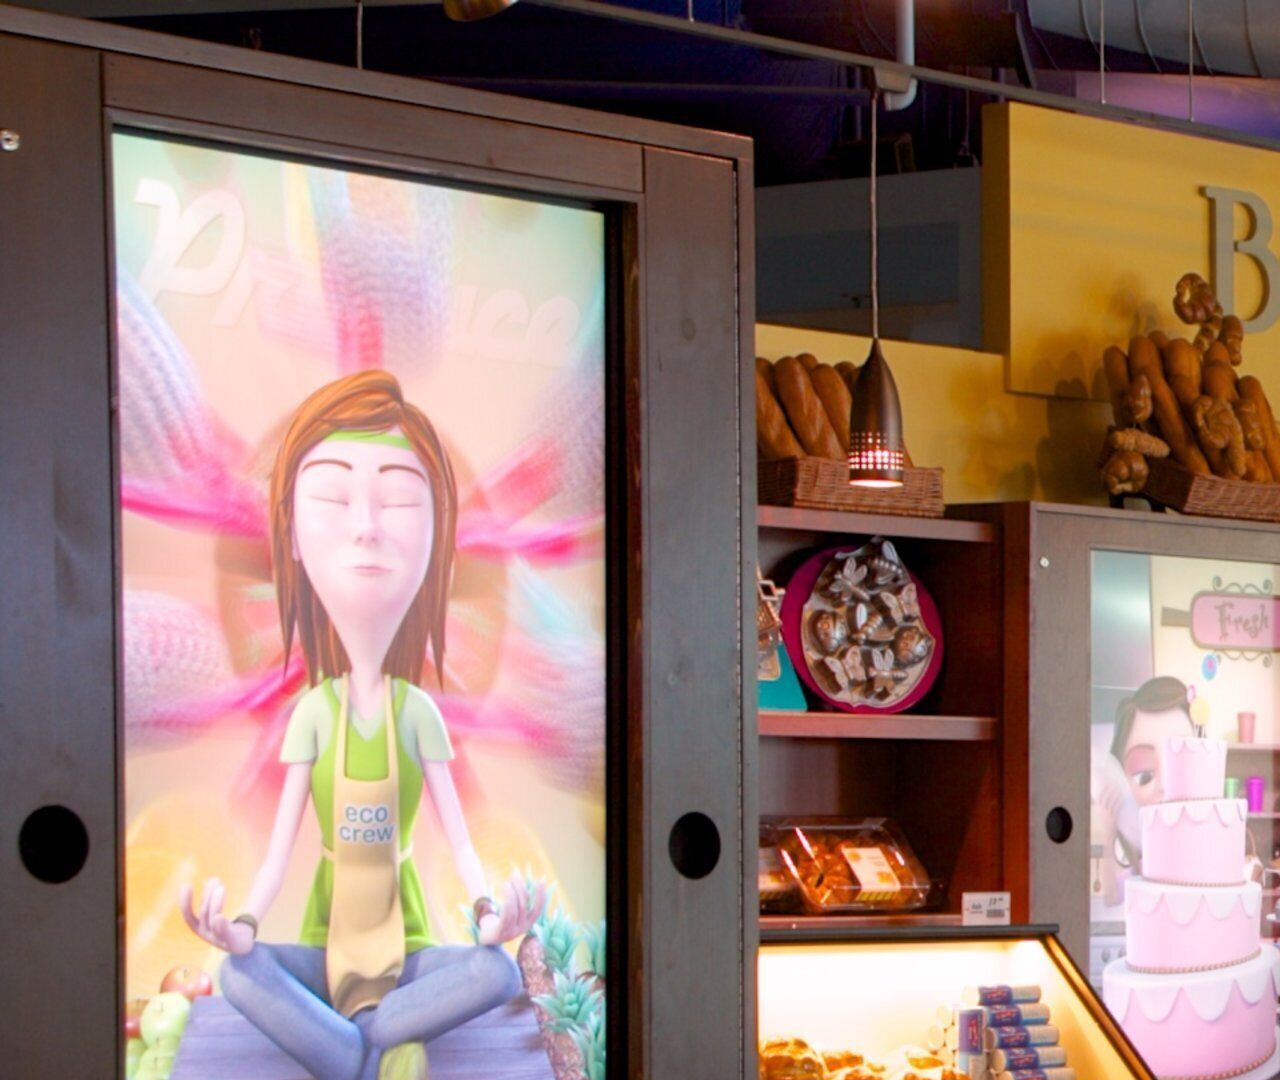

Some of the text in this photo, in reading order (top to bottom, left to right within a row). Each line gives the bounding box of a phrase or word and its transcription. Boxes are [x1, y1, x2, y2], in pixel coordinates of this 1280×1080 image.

[1213, 602, 1269, 642] Fresh
[344, 804, 390, 825] eco
[338, 825, 395, 844] crew
